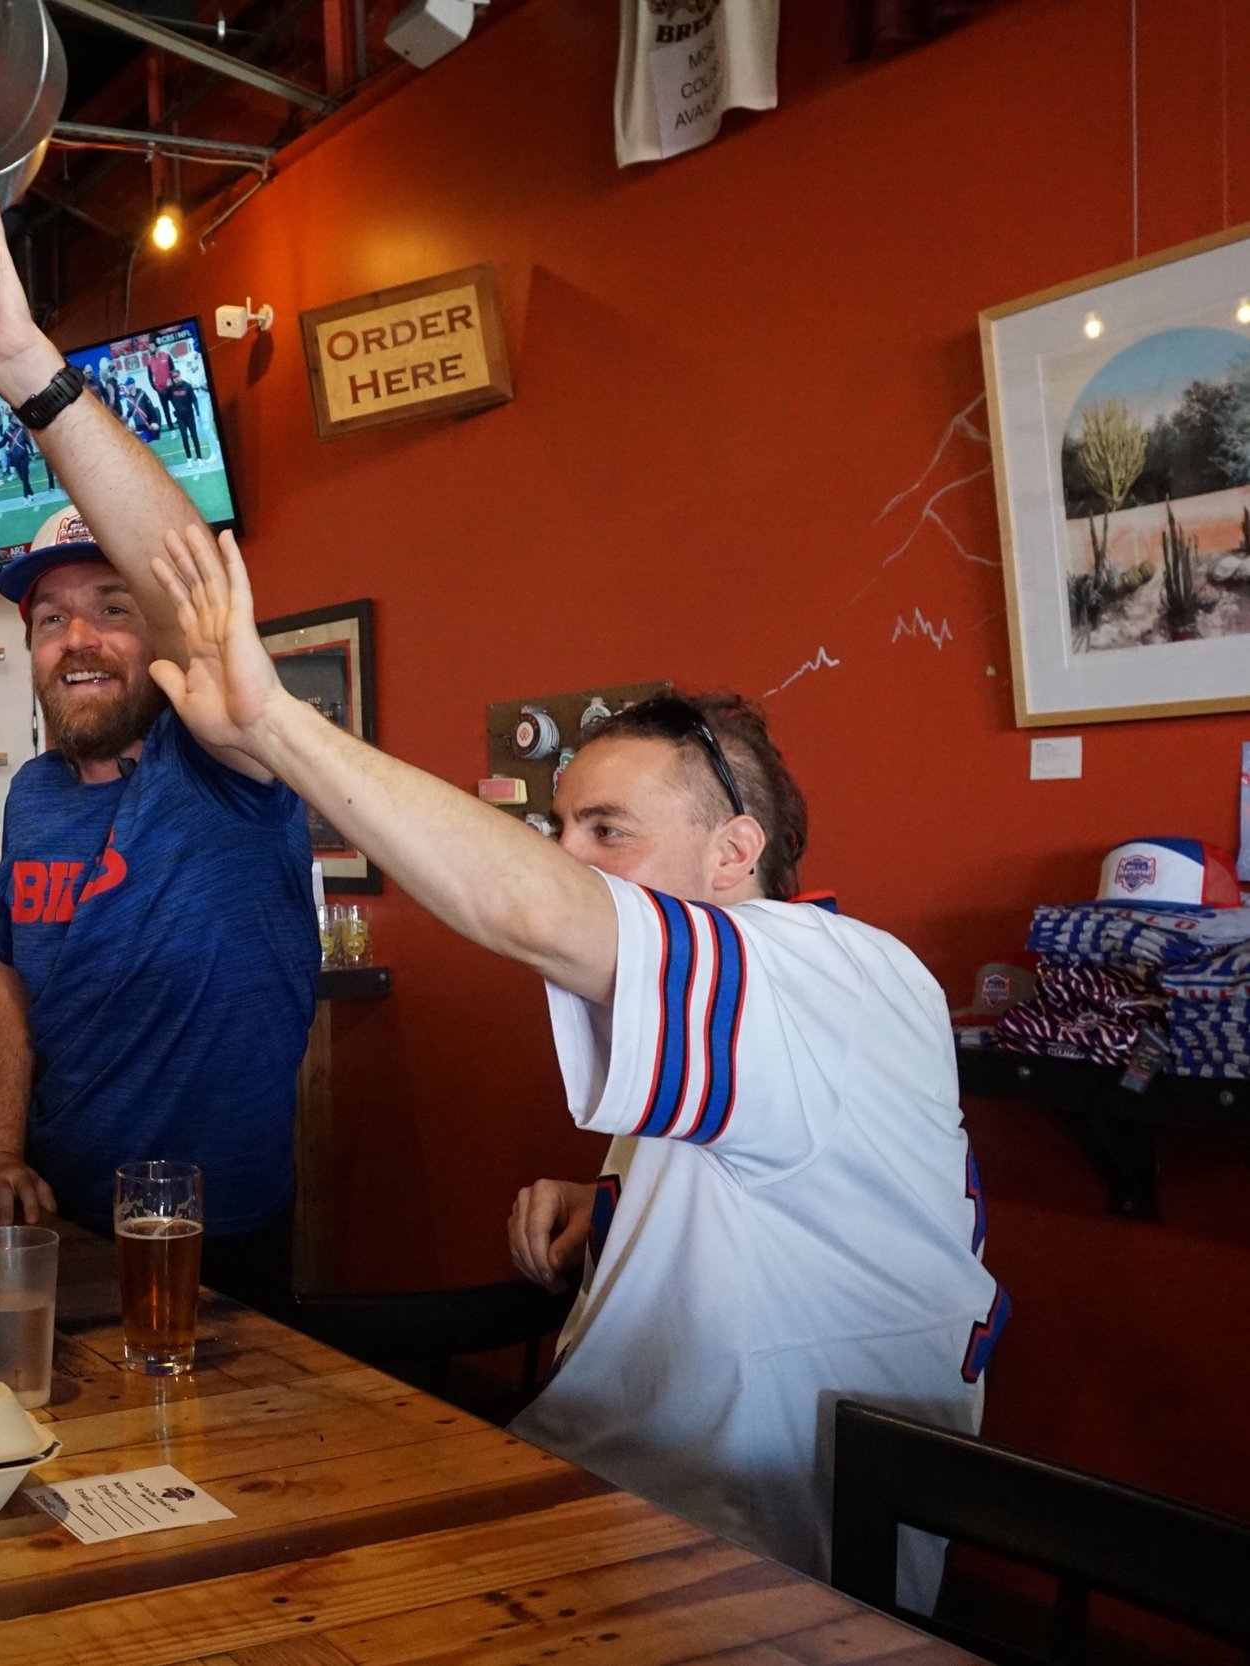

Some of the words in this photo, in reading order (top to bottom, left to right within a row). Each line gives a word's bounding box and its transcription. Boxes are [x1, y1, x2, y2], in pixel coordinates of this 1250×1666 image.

[326, 304, 474, 361] ORDER
[348, 353, 466, 405] HERE
[10, 545, 25, 556] ARZ
